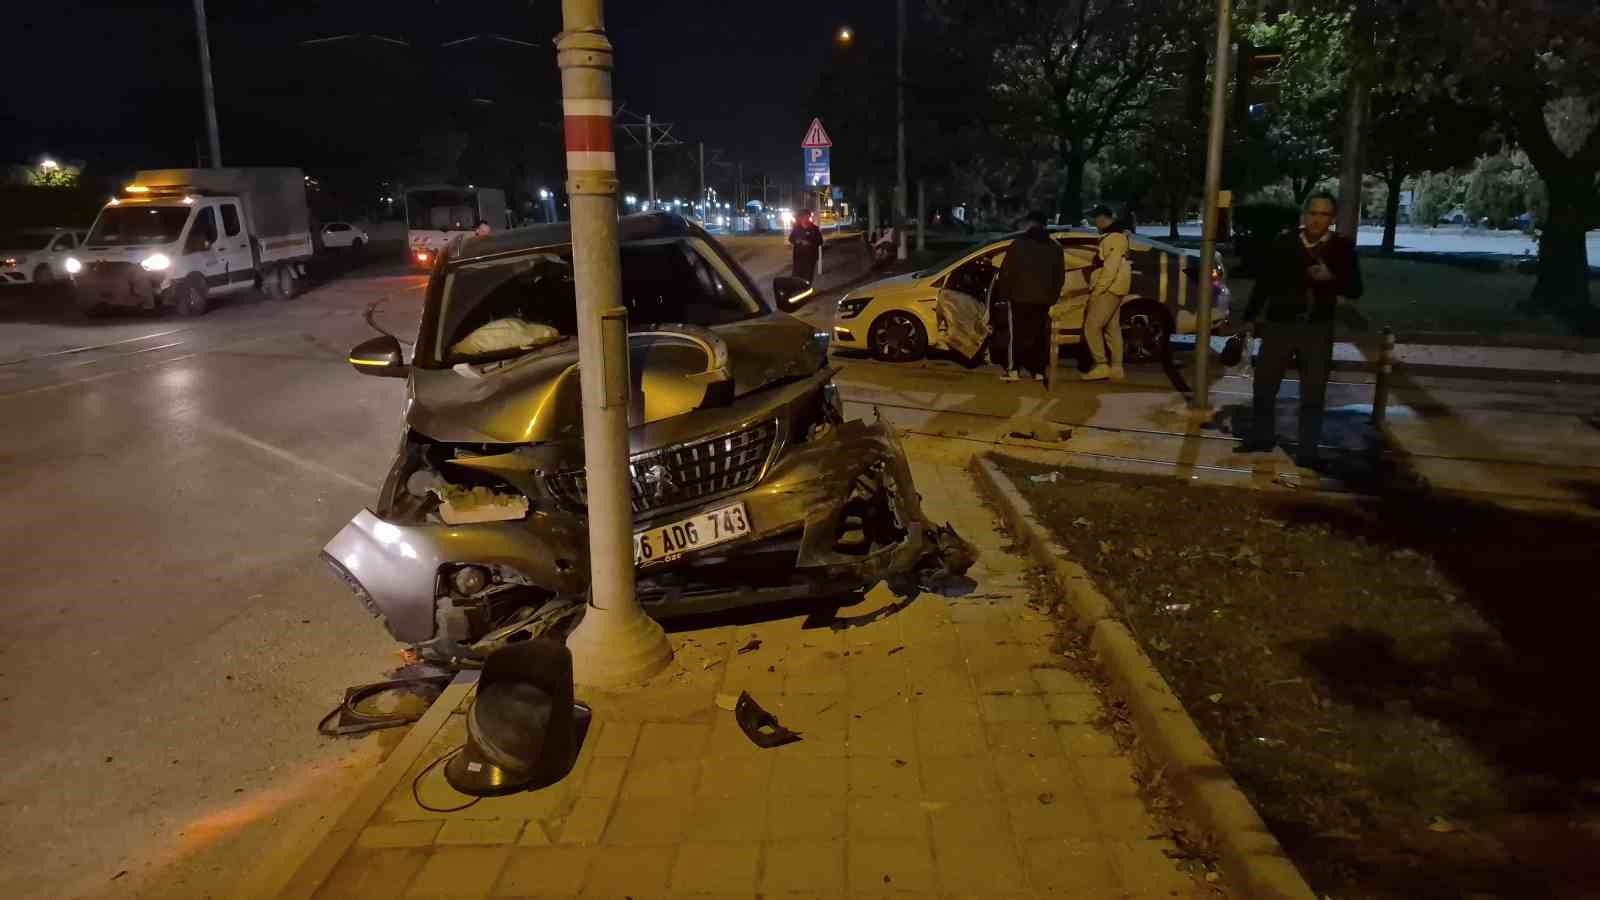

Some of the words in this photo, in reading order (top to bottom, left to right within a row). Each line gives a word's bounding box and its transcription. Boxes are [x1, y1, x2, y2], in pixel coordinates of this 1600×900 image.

[812, 148, 822, 162] P
[639, 535, 653, 559] 6
[662, 521, 698, 554] ADG
[707, 507, 746, 540] 743
